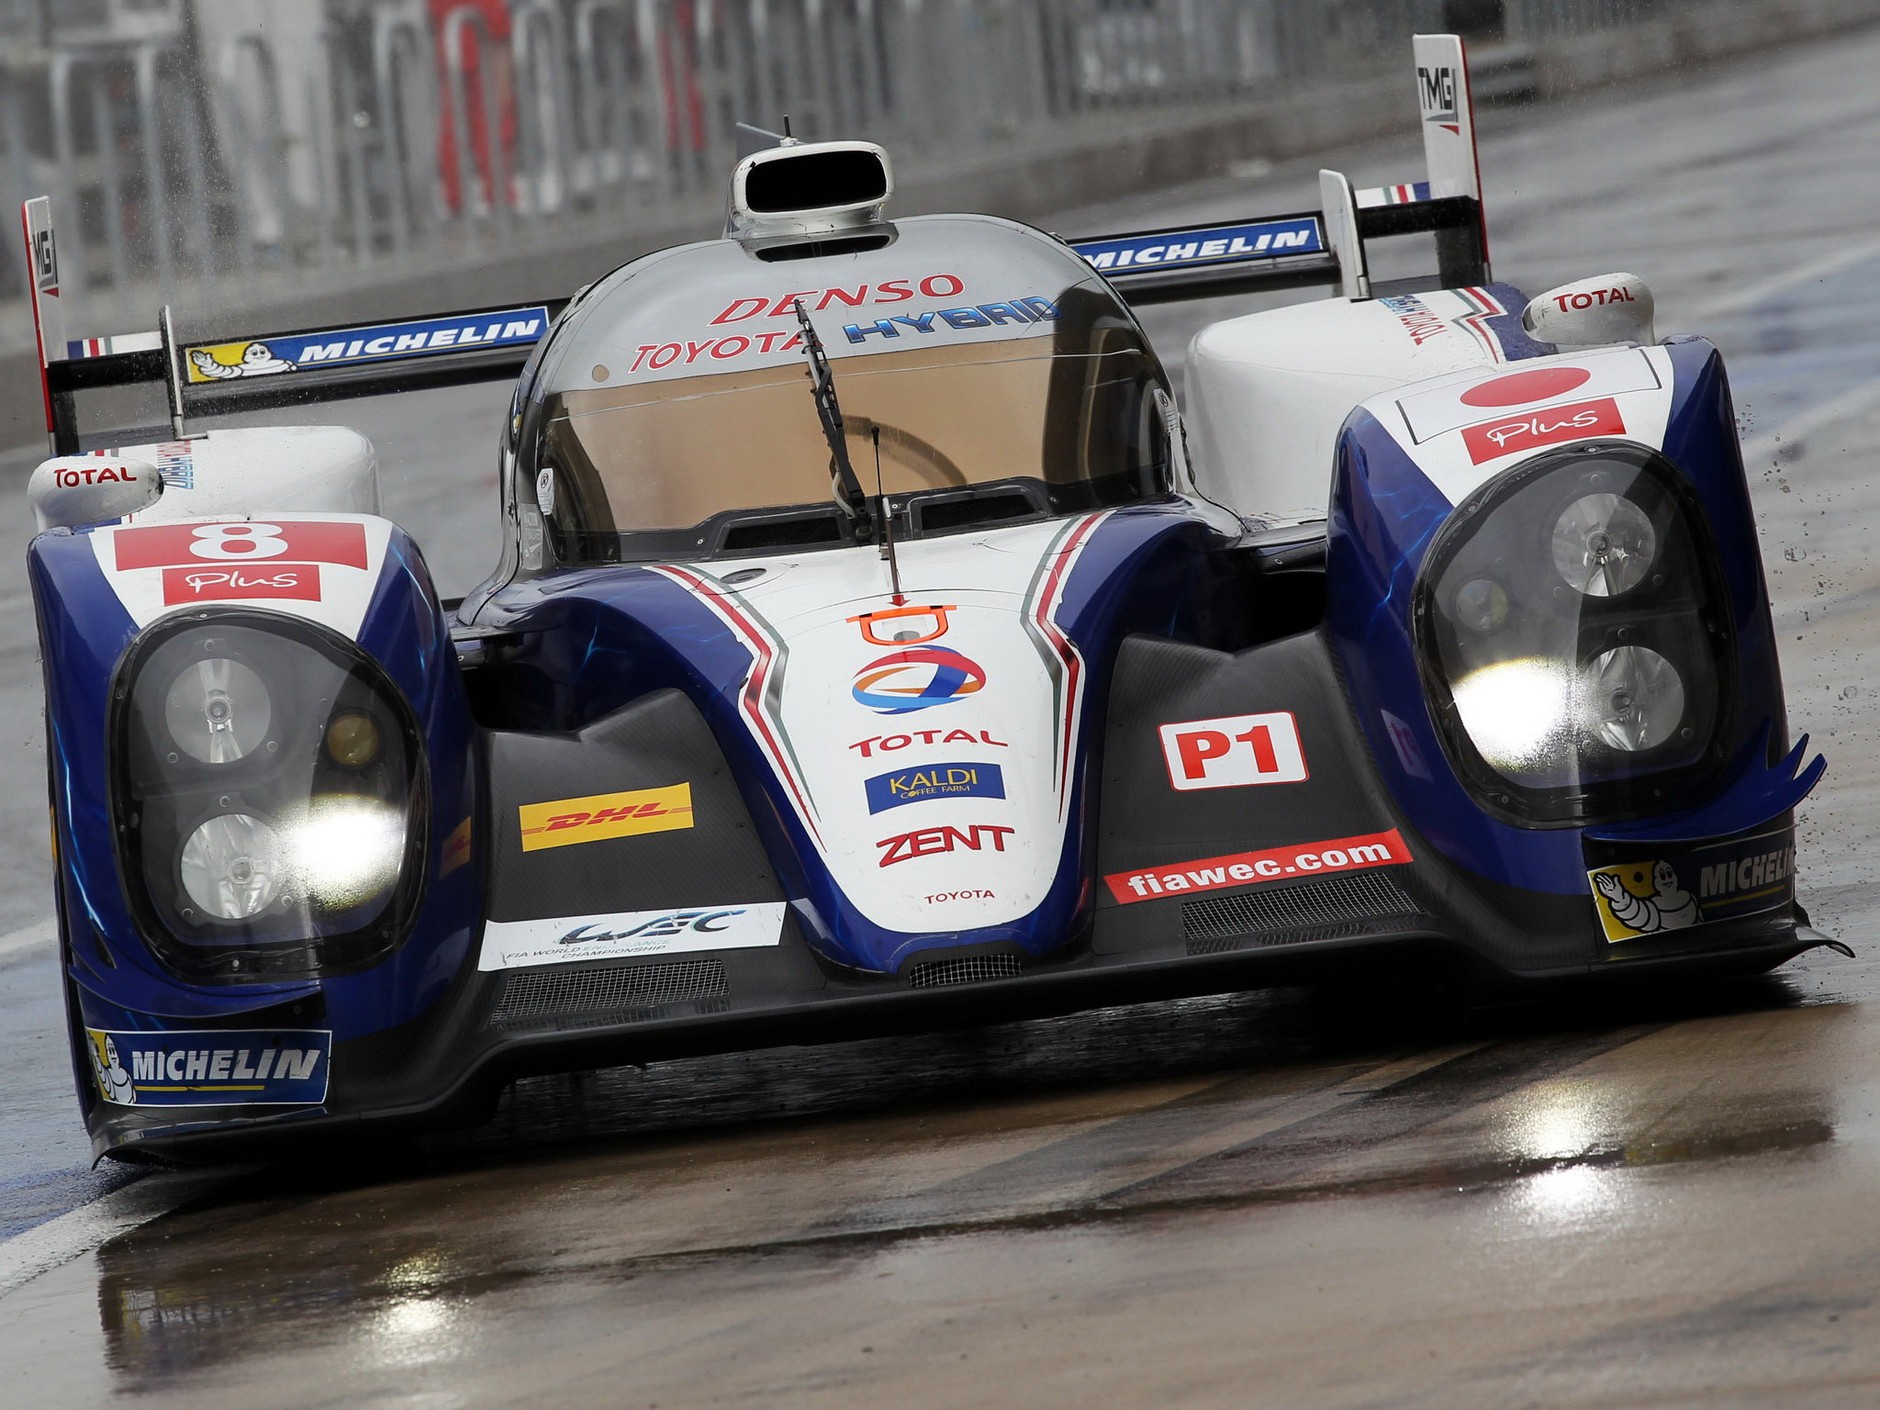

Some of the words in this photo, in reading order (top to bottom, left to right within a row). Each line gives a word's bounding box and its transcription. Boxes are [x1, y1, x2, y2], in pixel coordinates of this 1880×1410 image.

[1418, 67, 1453, 110] TMG
[707, 273, 966, 328] DENSO
[1553, 284, 1636, 314] TOTAL
[843, 296, 1063, 344] HYBRID
[300, 319, 539, 362] MICHELIN
[1485, 409, 1600, 449] Plus
[54, 466, 137, 488] TOTAL
[189, 523, 288, 560] 8
[185, 571, 298, 594] Plus
[848, 728, 1008, 759] TOTAL
[1176, 723, 1280, 780] P1
[889, 768, 978, 795] KALDI
[900, 787, 938, 800] COFFEE
[941, 785, 970, 793] FARM
[544, 803, 670, 832] DHL
[876, 825, 1015, 868] ZENT
[1127, 842, 1392, 897] fiawec.com
[924, 890, 995, 904] TOYOTA
[506, 952, 528, 960] FIA
[533, 947, 581, 957] WORLD
[562, 945, 667, 959] CHAMPIONSHIP
[132, 1049, 320, 1080] MICHELIN
